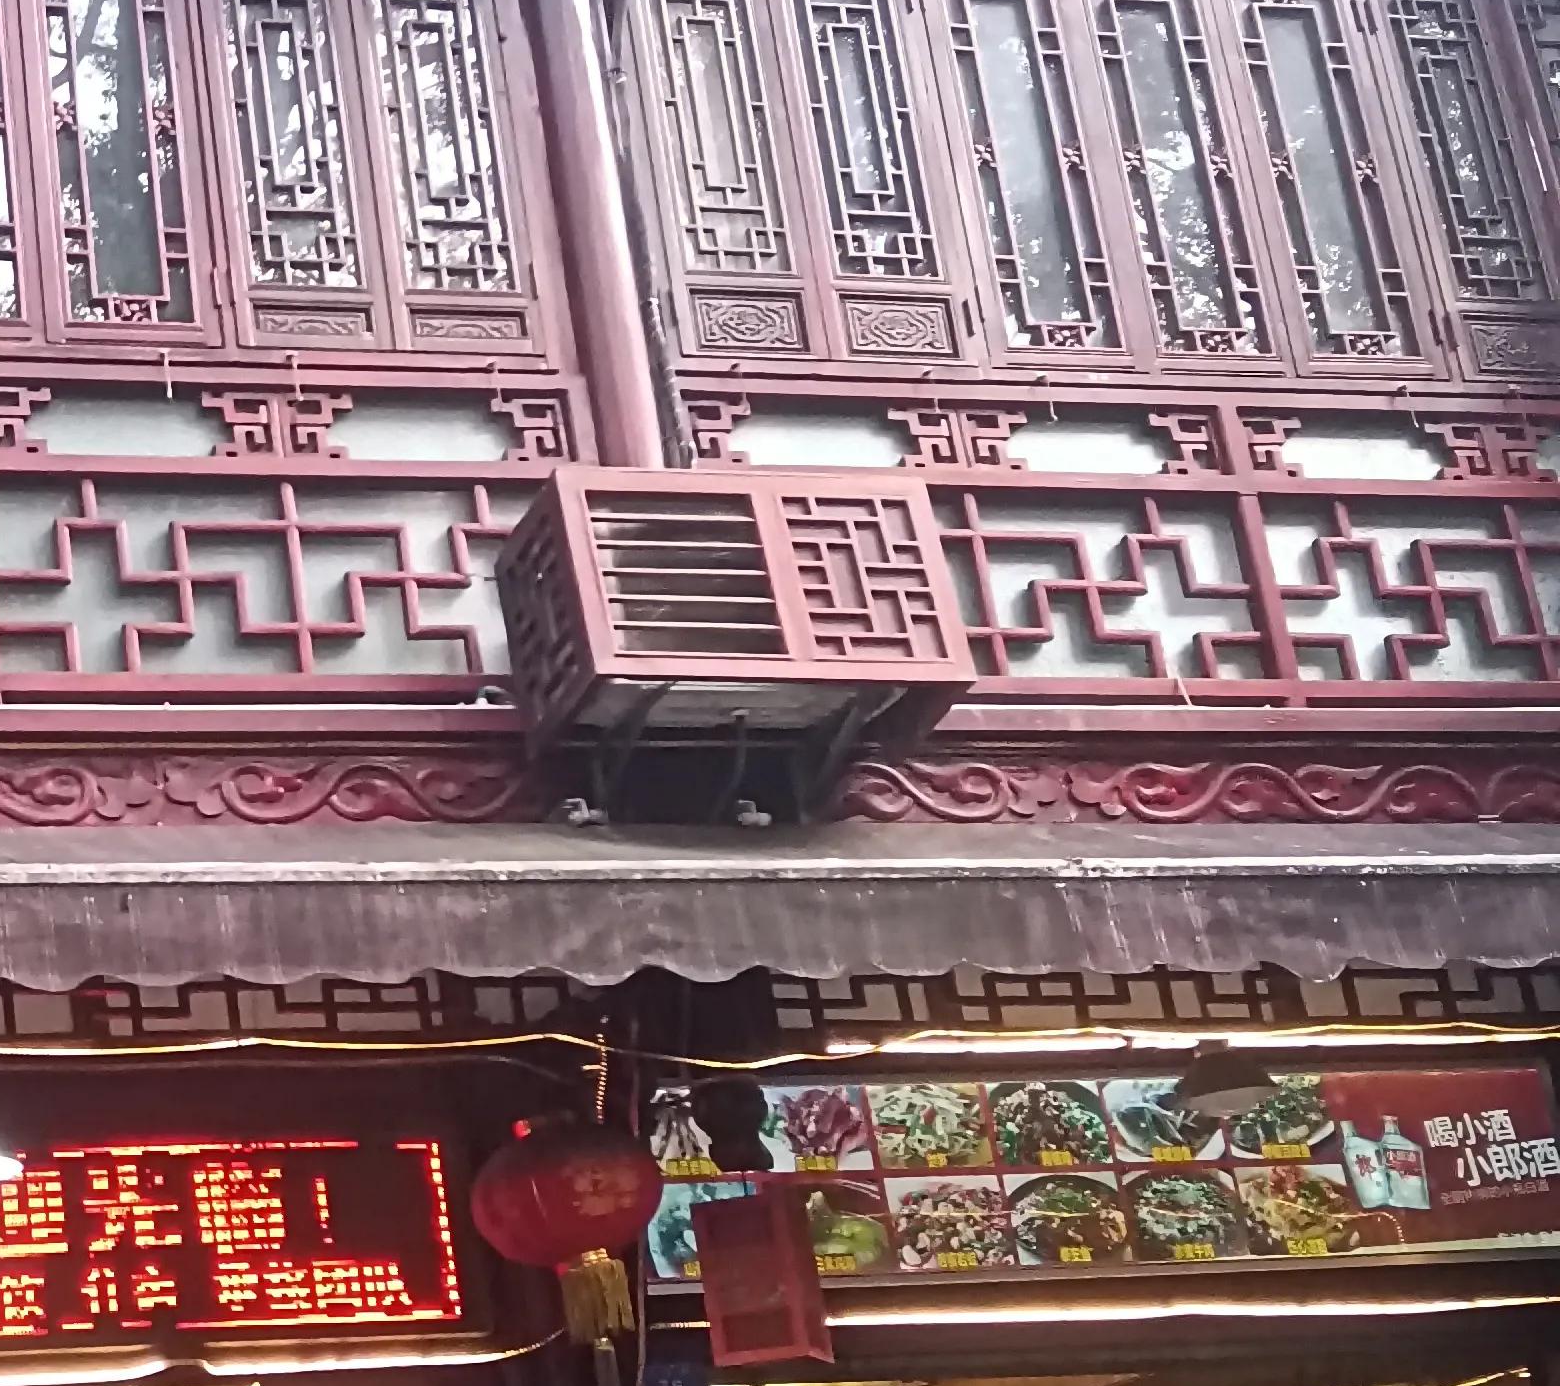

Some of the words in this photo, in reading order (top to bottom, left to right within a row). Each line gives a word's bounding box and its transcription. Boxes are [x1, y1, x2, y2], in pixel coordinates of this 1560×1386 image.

[1423, 1109, 1517, 1148] 喝小酒
[1456, 1138, 1560, 1187] 小郎酒
